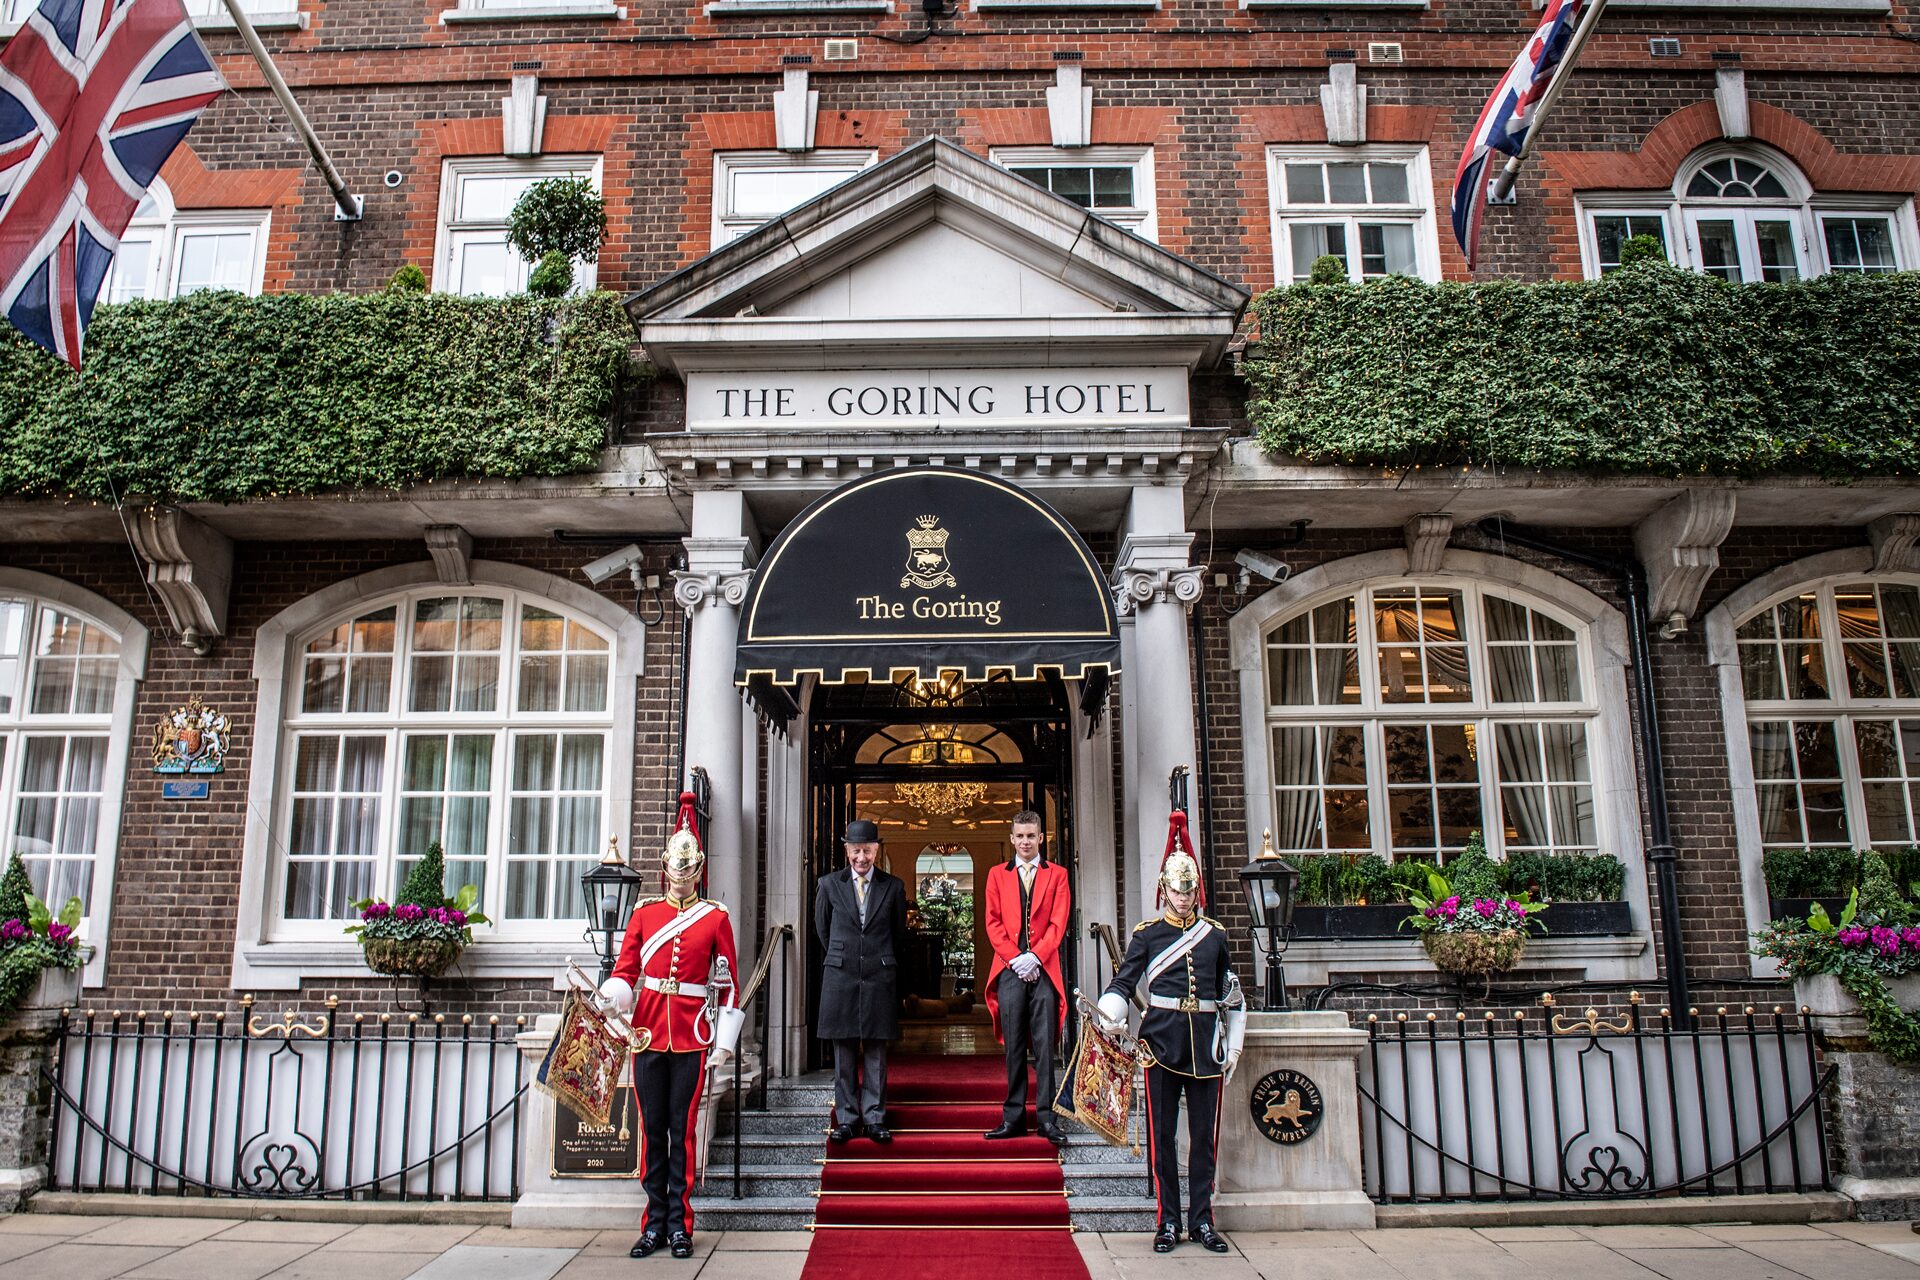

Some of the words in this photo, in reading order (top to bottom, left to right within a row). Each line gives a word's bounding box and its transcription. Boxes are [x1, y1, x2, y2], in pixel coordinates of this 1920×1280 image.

[716, 388, 797, 418] THE
[828, 384, 995, 417] GORING
[1024, 383, 1166, 415] HOTEL
[856, 595, 906, 619] The
[912, 594, 1002, 626] Goring
[1254, 1076, 1276, 1101] PRIDE
[1278, 1072, 1290, 1082] OF
[1294, 1074, 1320, 1106] BRITAIN
[1269, 1127, 1307, 1142] MEMBER
[586, 1159, 605, 1167] 2020
